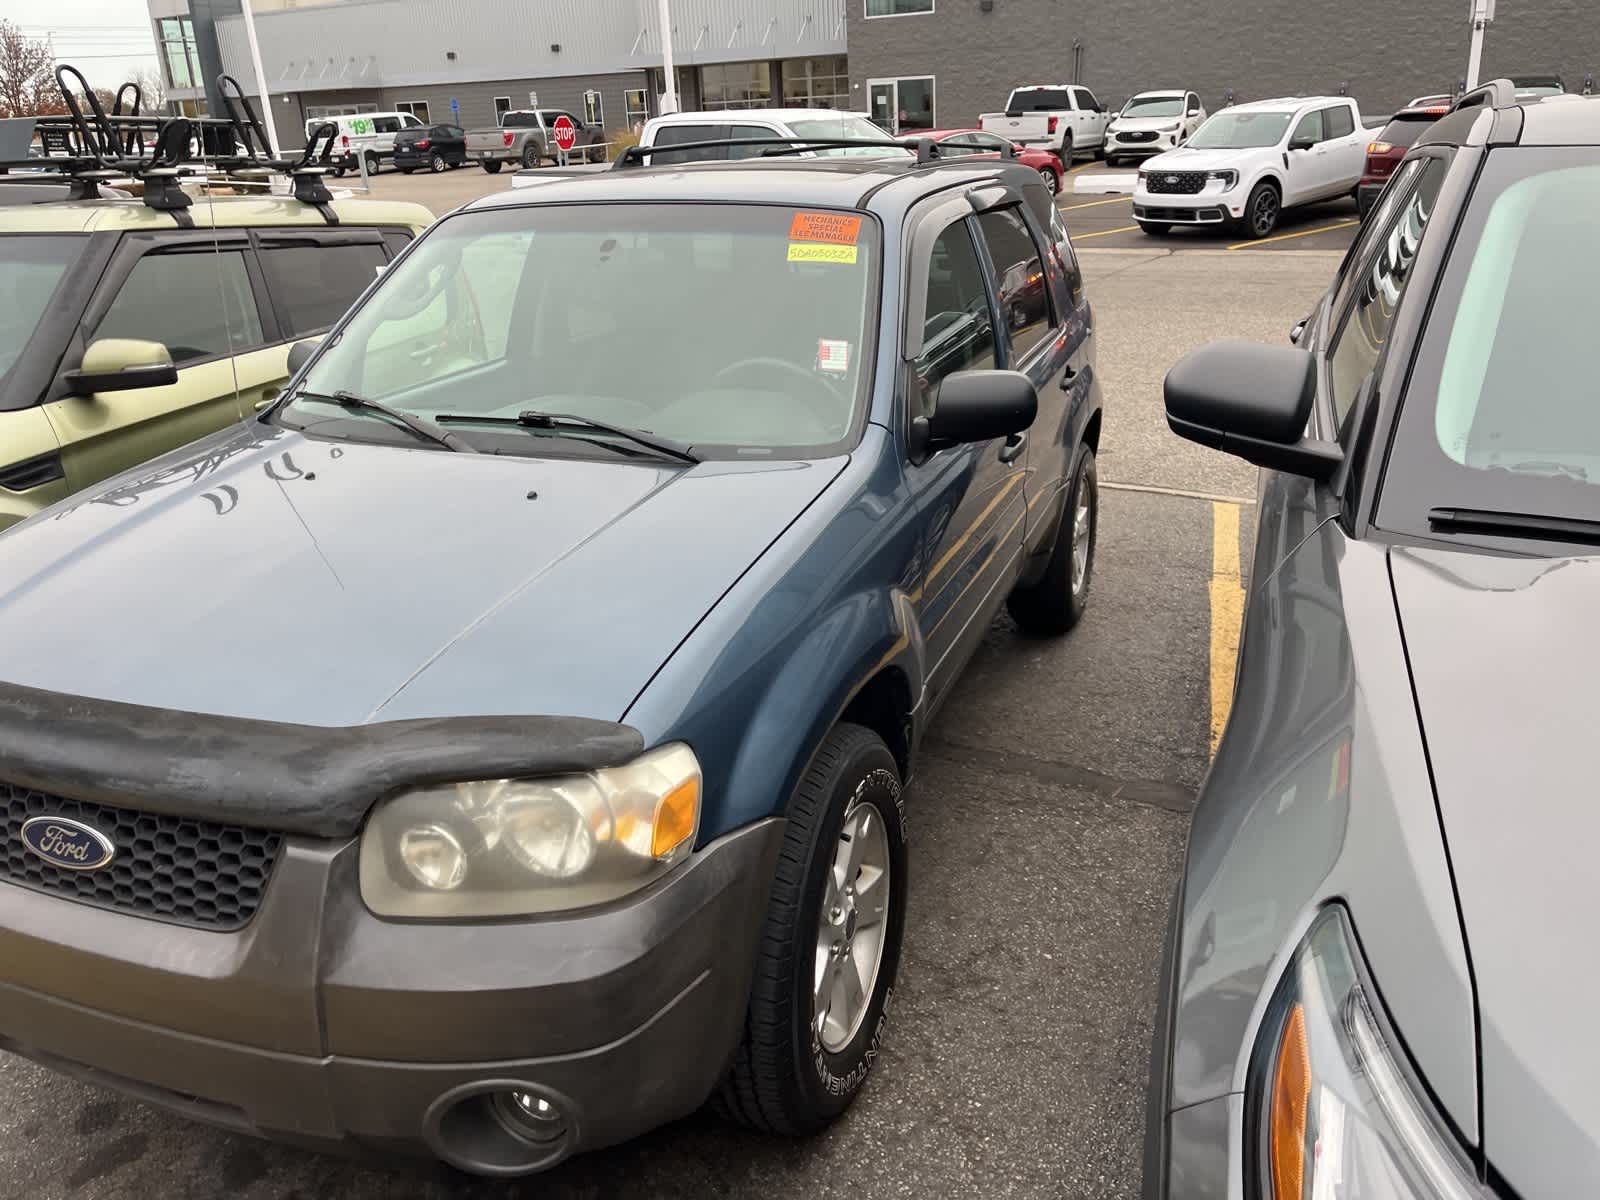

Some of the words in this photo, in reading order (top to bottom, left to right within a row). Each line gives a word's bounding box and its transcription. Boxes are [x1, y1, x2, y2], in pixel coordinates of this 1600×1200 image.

[555, 127, 574, 141] STOP
[808, 223, 844, 234] SPECIAL
[40, 825, 90, 860] Ford
